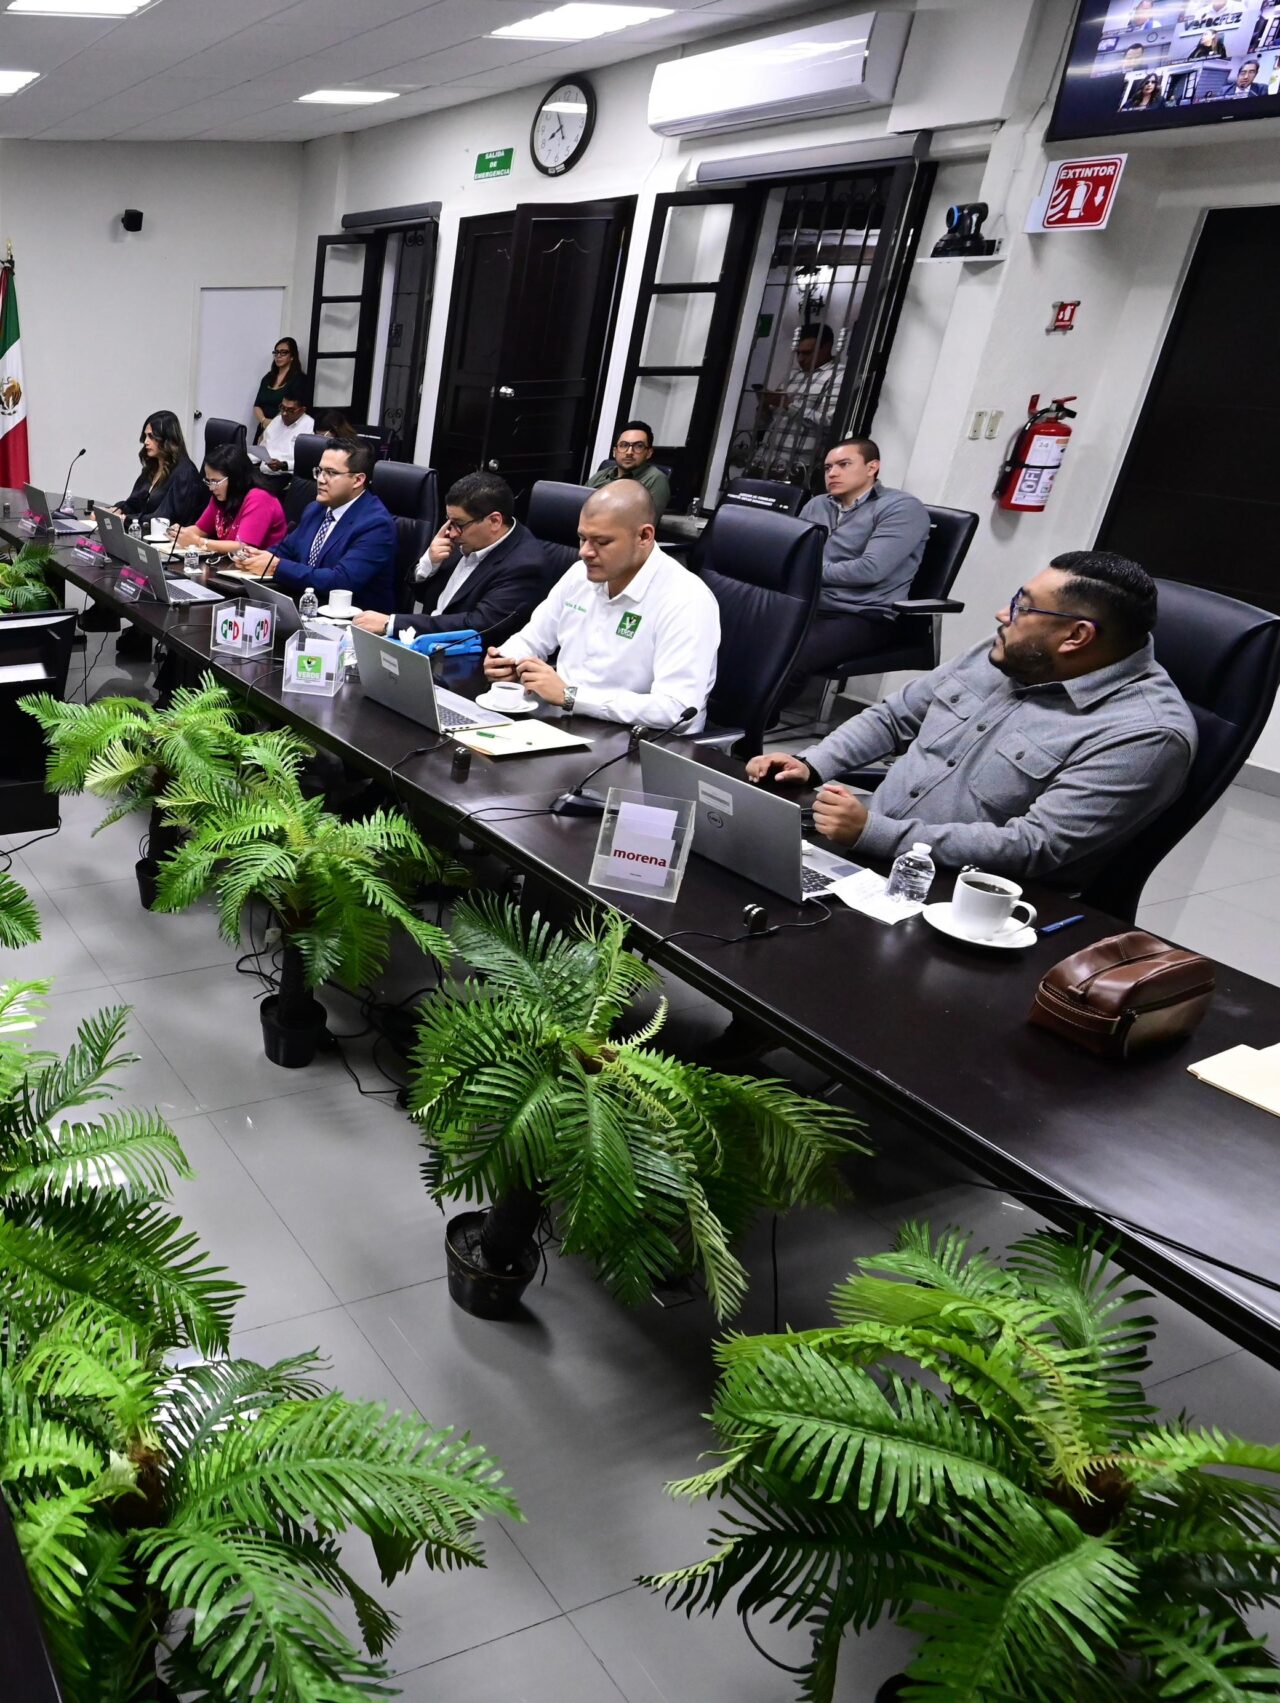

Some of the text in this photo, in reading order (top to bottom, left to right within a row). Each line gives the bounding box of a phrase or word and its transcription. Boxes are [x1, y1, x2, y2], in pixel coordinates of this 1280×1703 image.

[484, 150, 505, 160] SALIDA
[1060, 165, 1115, 179] EXTINTOR
[613, 849, 667, 867] morena
